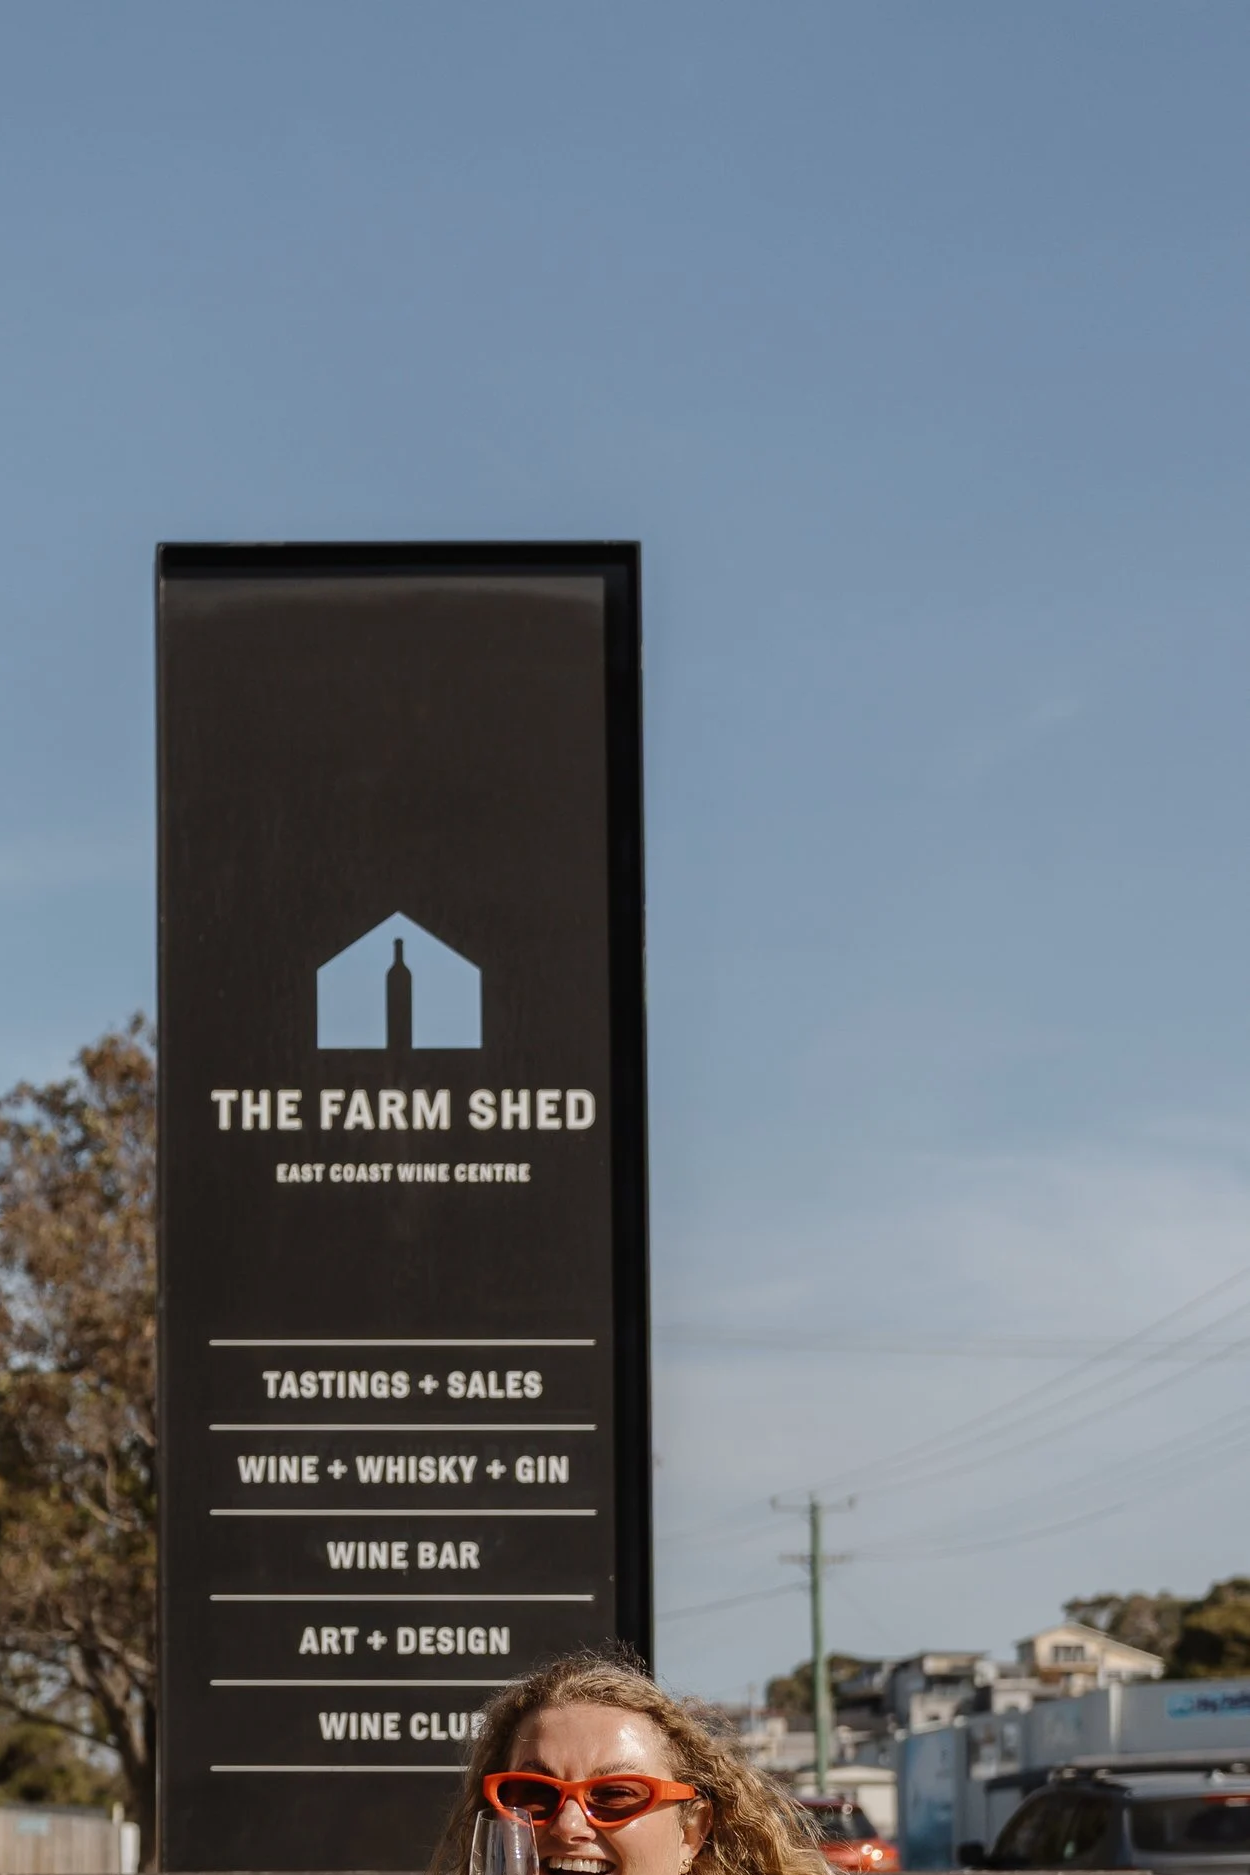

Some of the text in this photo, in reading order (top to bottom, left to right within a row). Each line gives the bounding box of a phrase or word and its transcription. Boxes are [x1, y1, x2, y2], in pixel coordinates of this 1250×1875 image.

[210, 1088, 596, 1131] THE FARM SHED
[276, 1162, 531, 1183] EAST COAST WINE CENTRE
[262, 1370, 543, 1399] TASTINGS + SALES
[237, 1455, 570, 1484] WINE + WHISKY + GIN
[326, 1541, 481, 1570] WINE BAR
[298, 1626, 511, 1655] ART + DESIGN
[318, 1711, 402, 1741] WINE
